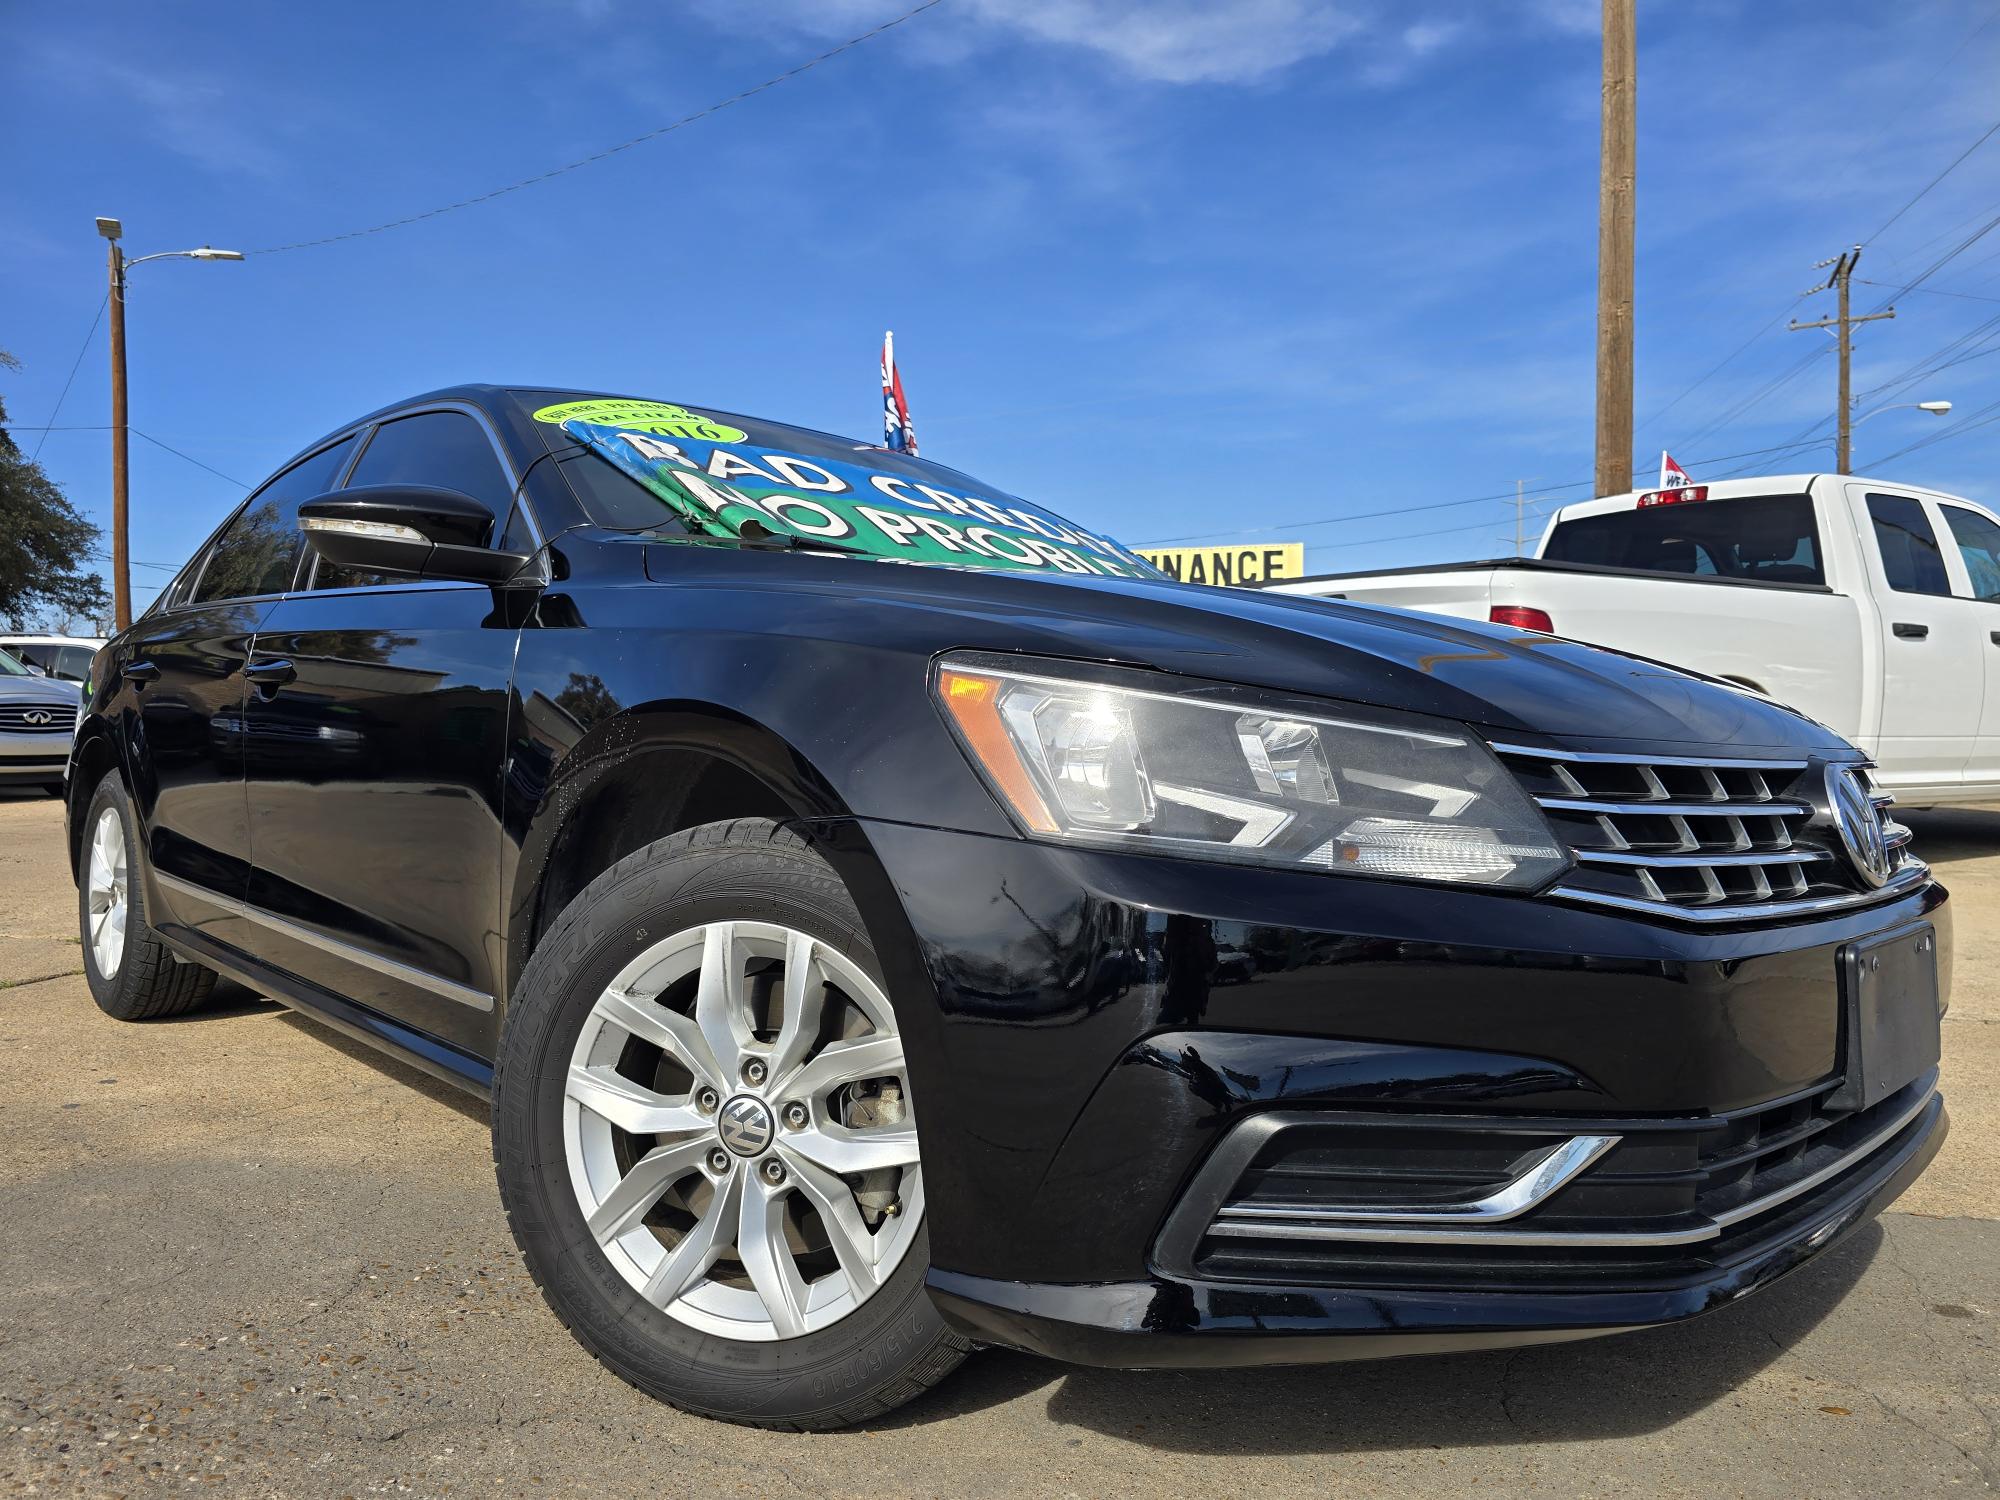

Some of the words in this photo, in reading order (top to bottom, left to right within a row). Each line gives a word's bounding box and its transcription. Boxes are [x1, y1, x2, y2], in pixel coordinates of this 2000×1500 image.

[649, 424, 721, 440] 016
[615, 432, 850, 492] BAD
[870, 475, 1137, 566] CREDIT
[670, 469, 851, 537] NO
[854, 506, 1146, 578] PROBLE
[1149, 550, 1284, 586] INANCE
[812, 1312, 925, 1399] 215/60R16
